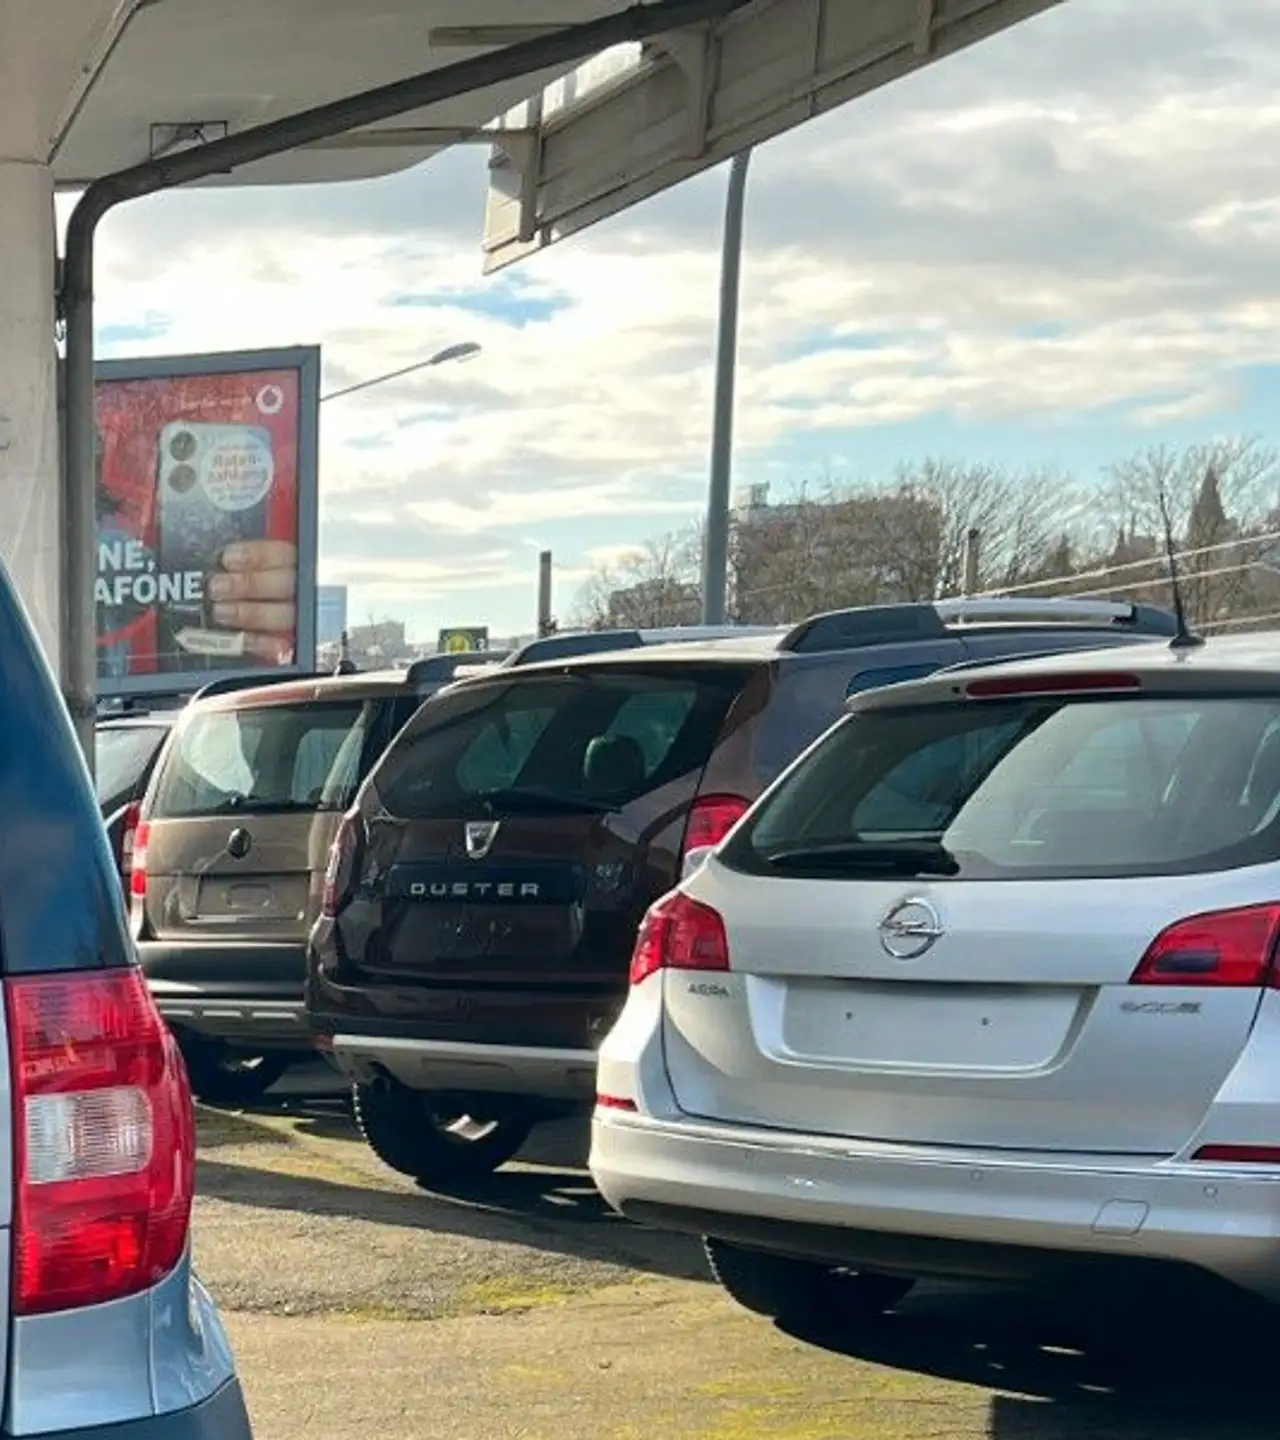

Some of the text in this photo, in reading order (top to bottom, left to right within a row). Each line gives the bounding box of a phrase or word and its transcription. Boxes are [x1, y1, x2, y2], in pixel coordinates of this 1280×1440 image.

[98, 540, 156, 572] NE,
[94, 571, 204, 605] AFONE
[410, 882, 540, 896] DUSTER
